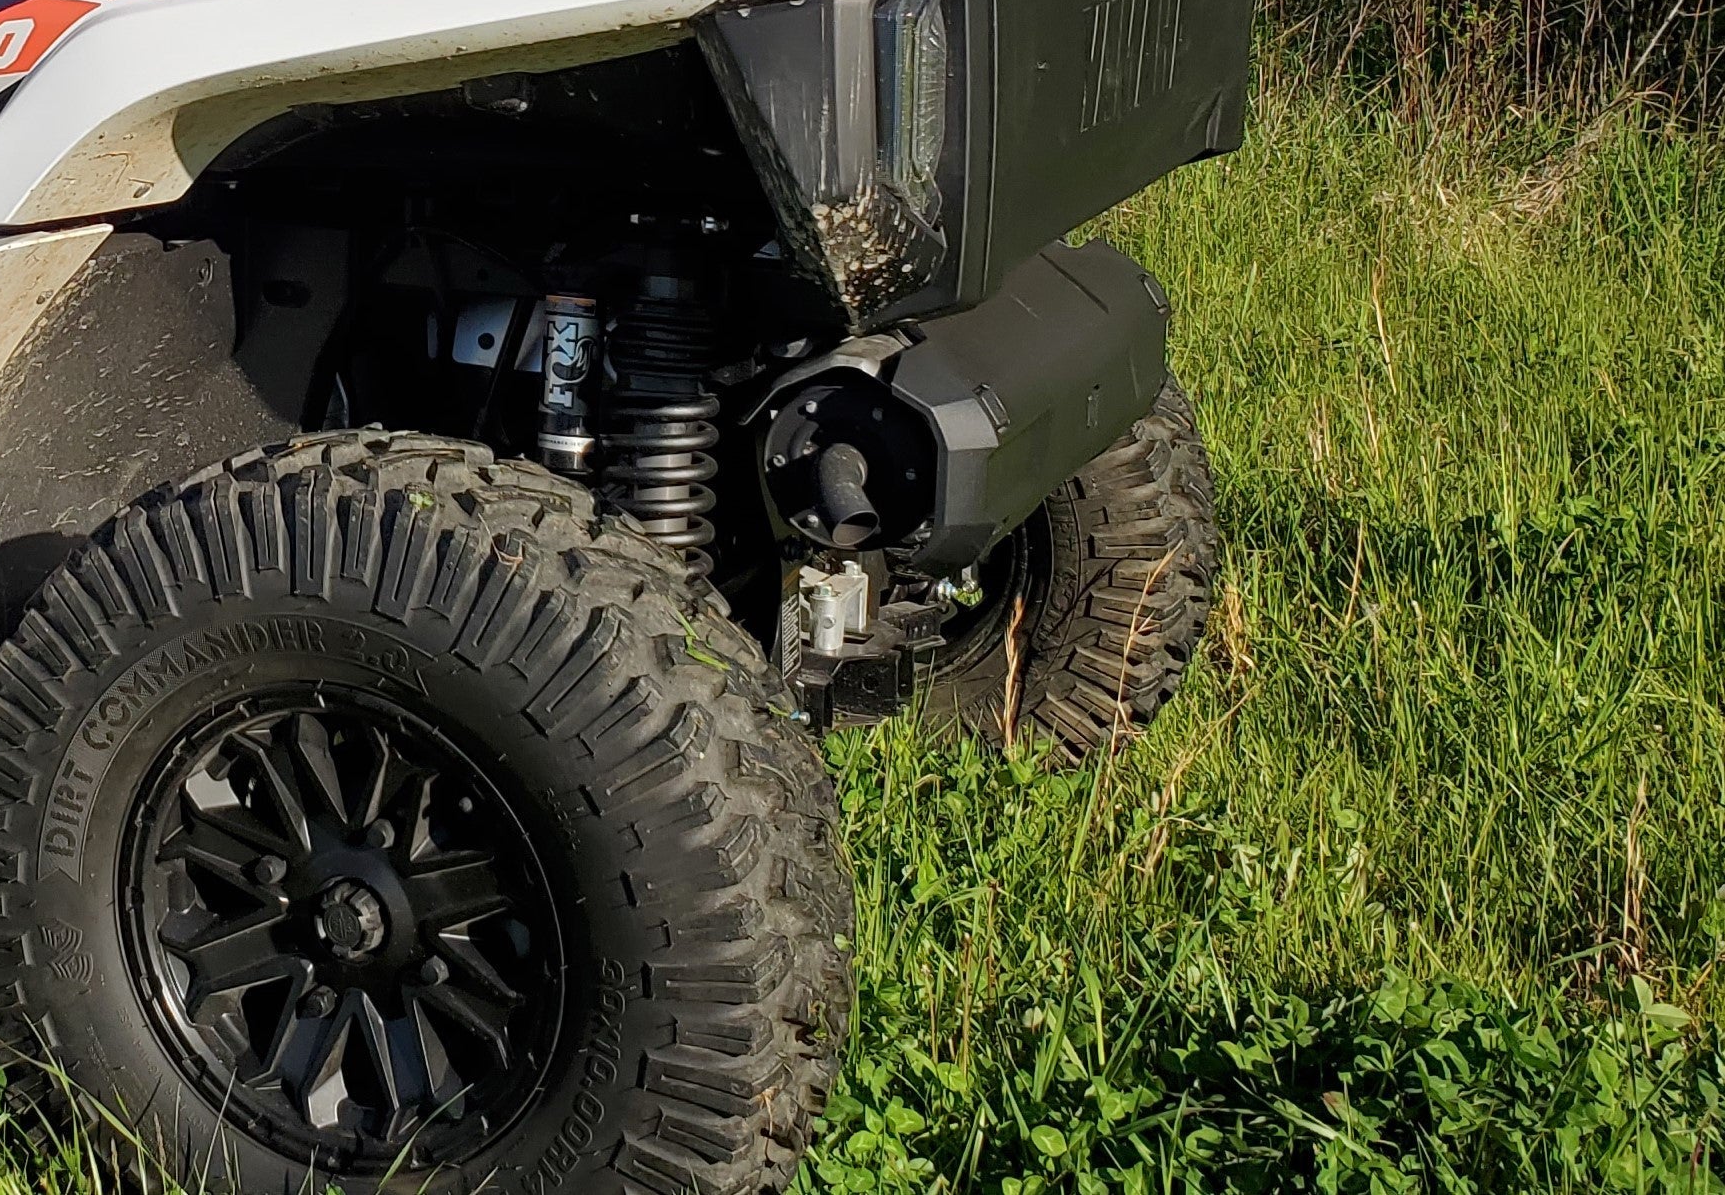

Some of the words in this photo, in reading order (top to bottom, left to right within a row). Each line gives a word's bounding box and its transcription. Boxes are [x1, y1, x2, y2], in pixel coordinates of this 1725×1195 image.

[545, 320, 592, 409] FOX
[43, 760, 94, 859] DIRT
[81, 618, 327, 751] COMMANDER
